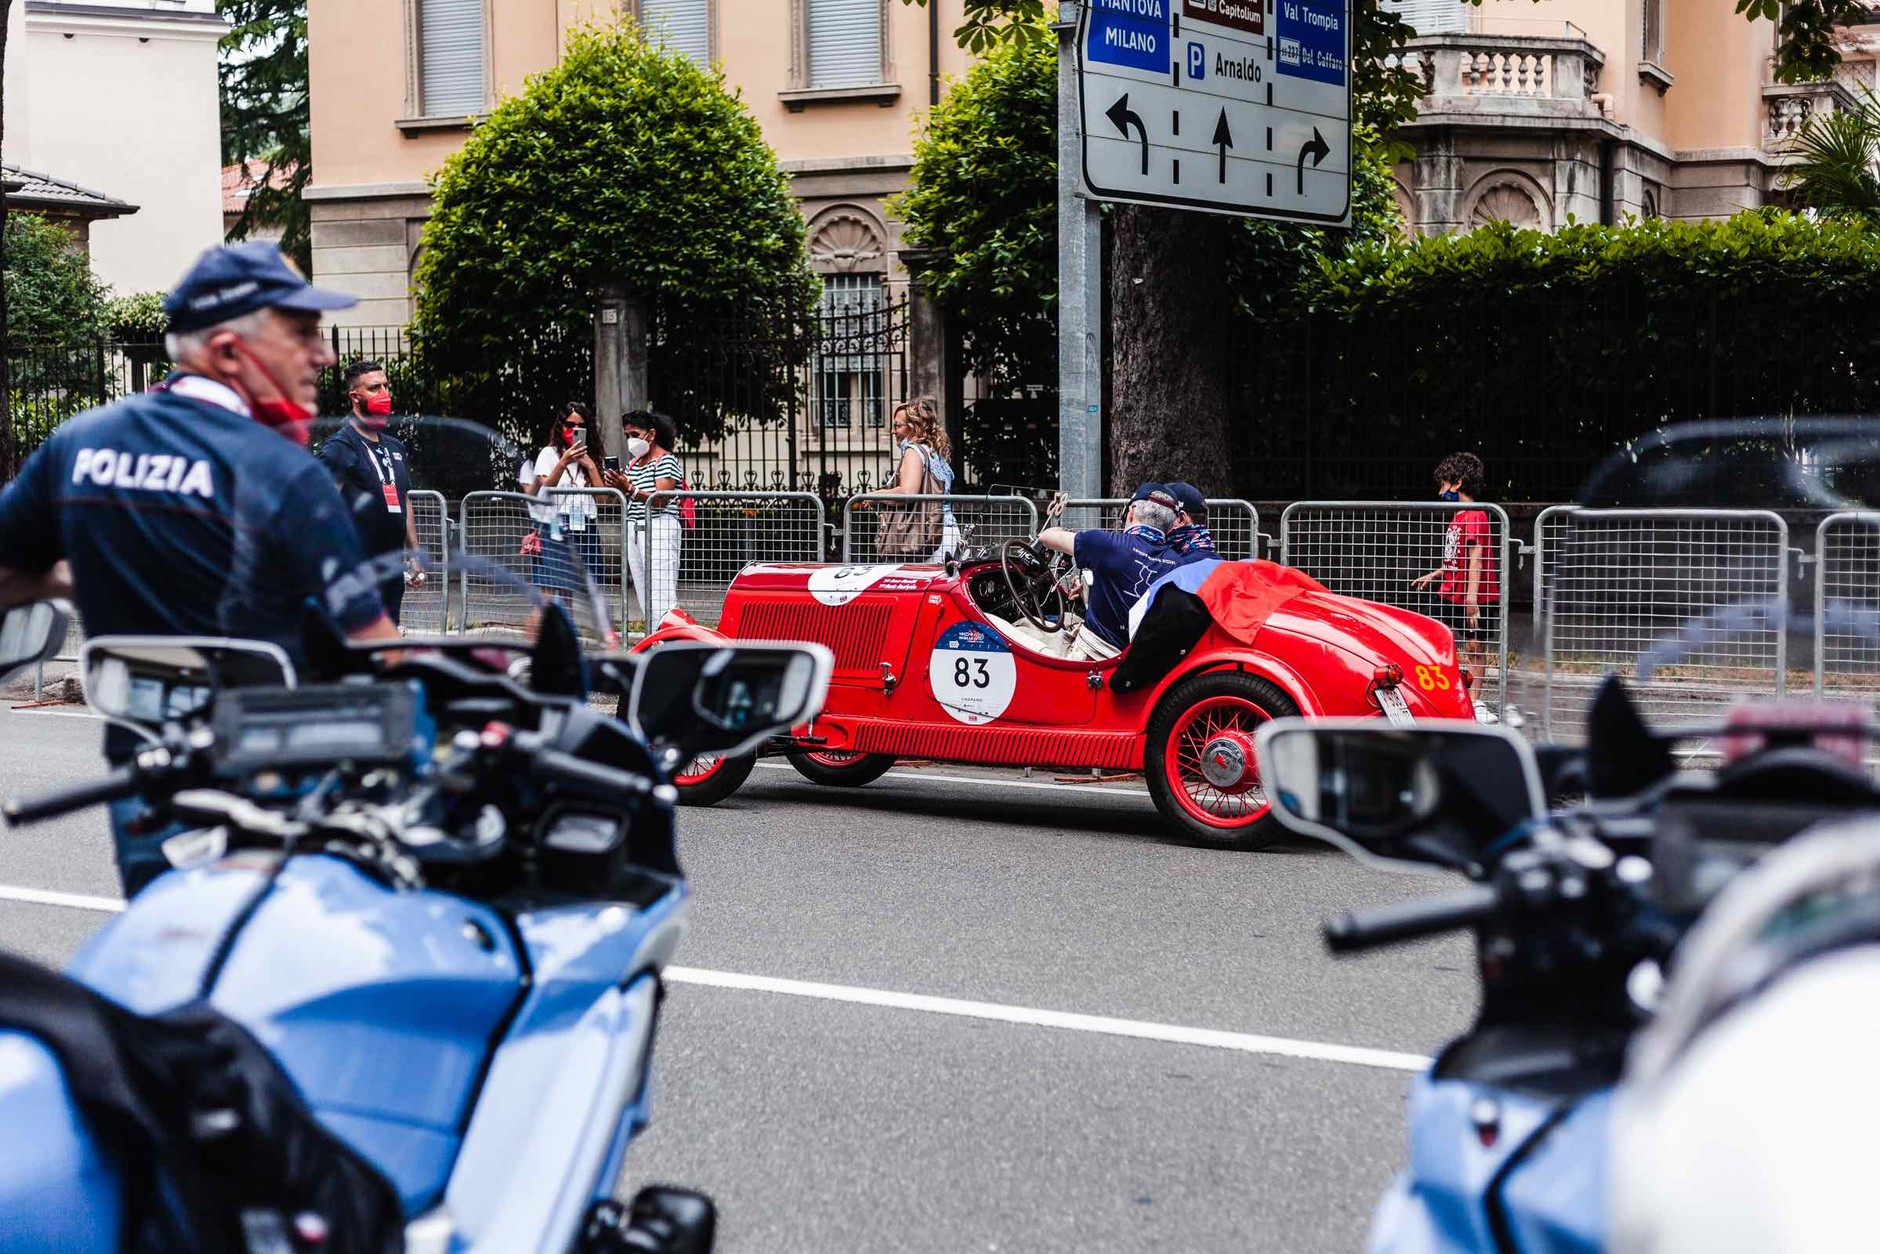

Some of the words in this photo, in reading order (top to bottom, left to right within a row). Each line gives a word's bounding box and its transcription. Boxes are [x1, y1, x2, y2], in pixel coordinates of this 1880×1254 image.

[1219, 0, 1261, 23] Capitolium
[1284, 2, 1299, 21] Val
[1302, 6, 1339, 31] Trompia
[1105, 26, 1156, 53] MILANO
[1190, 45, 1203, 76] P
[1216, 52, 1261, 83] Arnaldo
[1302, 47, 1314, 65] Del
[1317, 51, 1343, 71] Caffaro
[72, 448, 214, 498] POLIZIA
[954, 657, 990, 688] 83
[1414, 664, 1450, 690] 83
